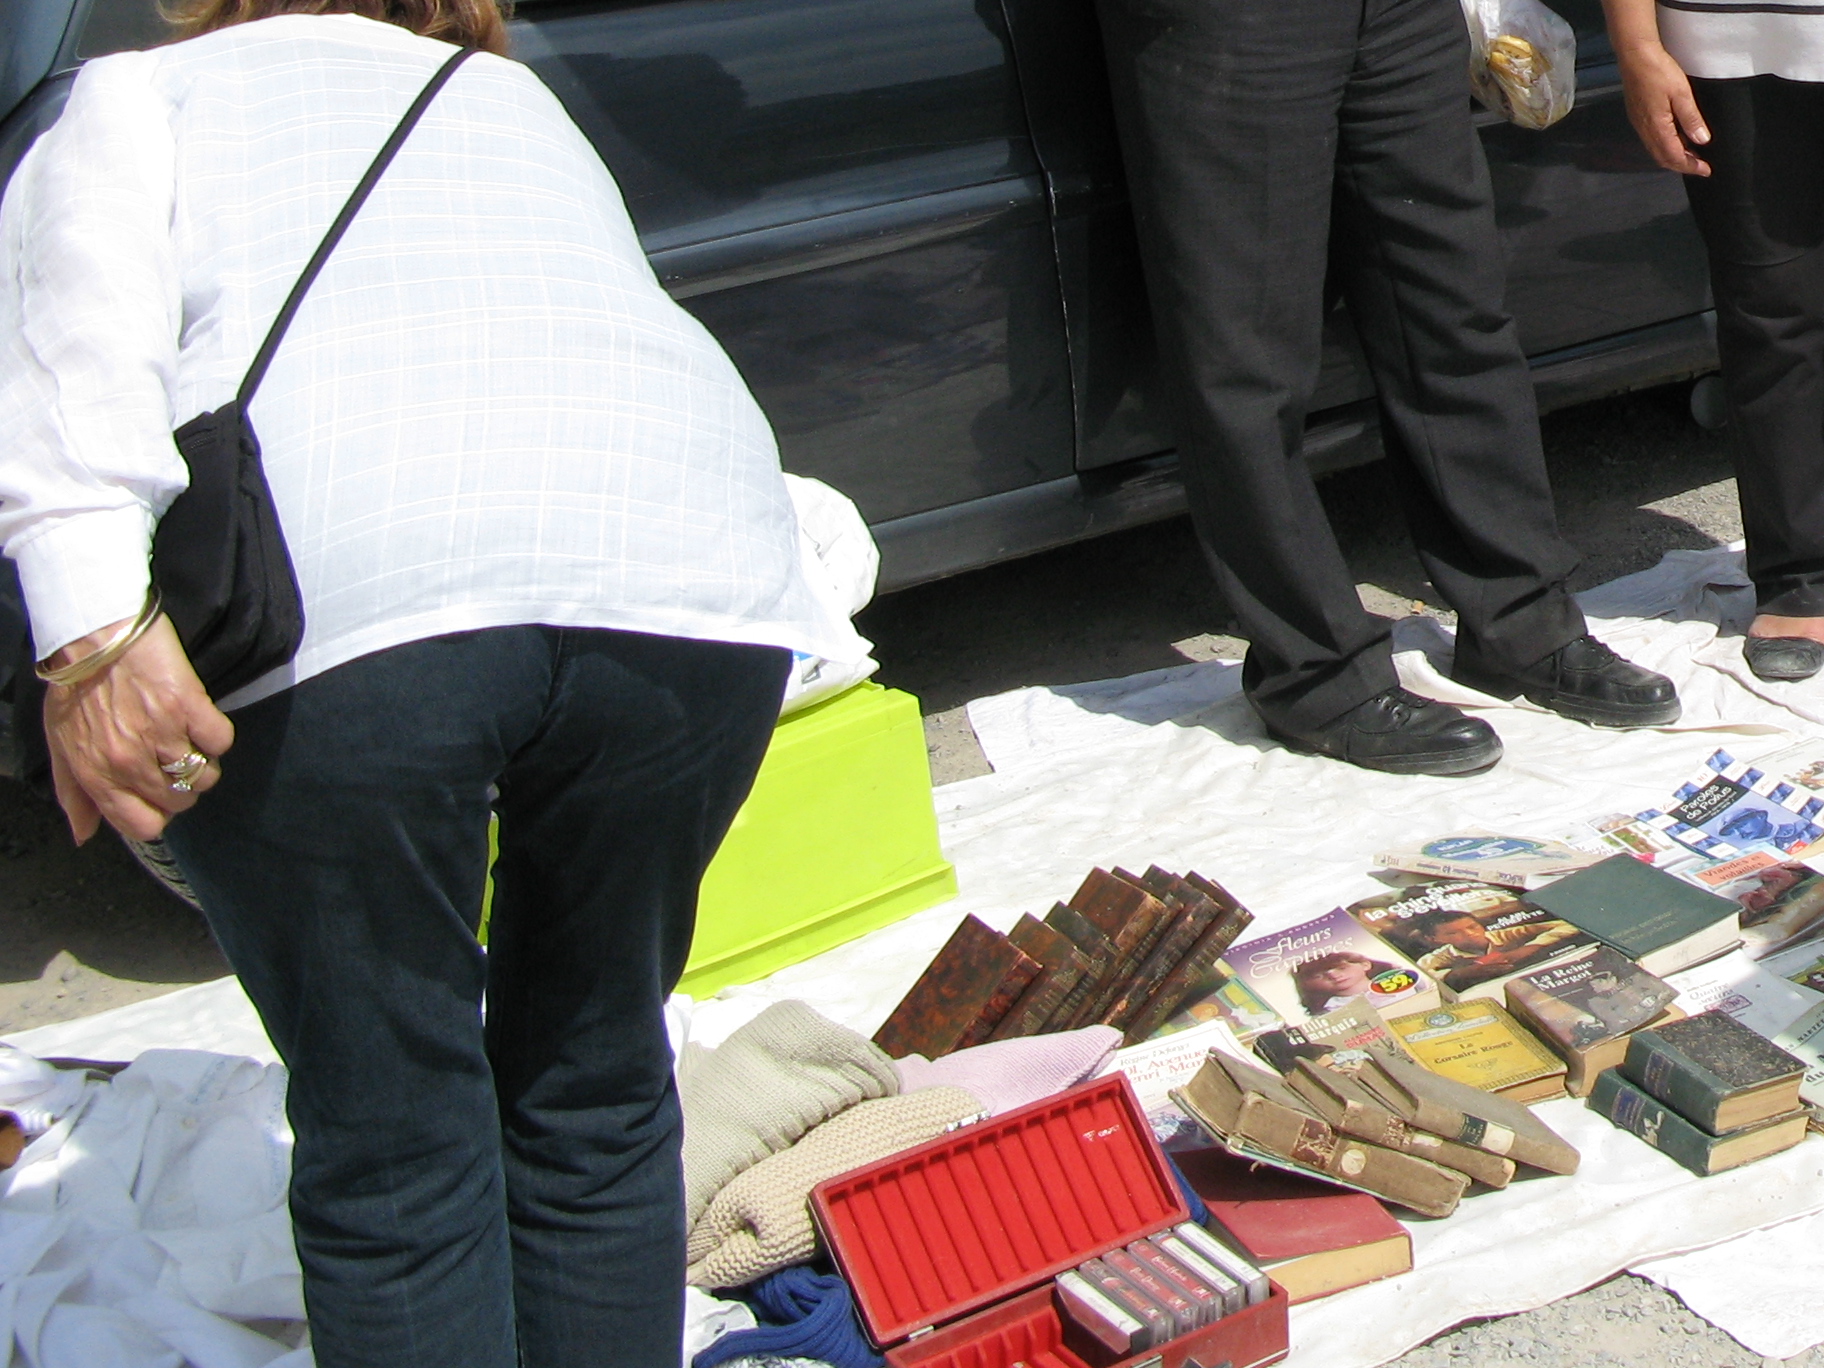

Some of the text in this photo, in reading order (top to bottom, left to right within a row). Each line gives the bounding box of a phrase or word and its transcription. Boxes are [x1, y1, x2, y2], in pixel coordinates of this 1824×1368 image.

[1702, 859, 1747, 879] Viandes
[1365, 906, 1388, 922] la
[1530, 959, 1594, 985] La Reine
[1536, 969, 1593, 992] Margot
[1308, 1017, 1358, 1041] marquis
[1147, 1048, 1207, 1071] Avenue
[1434, 1040, 1514, 1064] Corsaire Rouge
